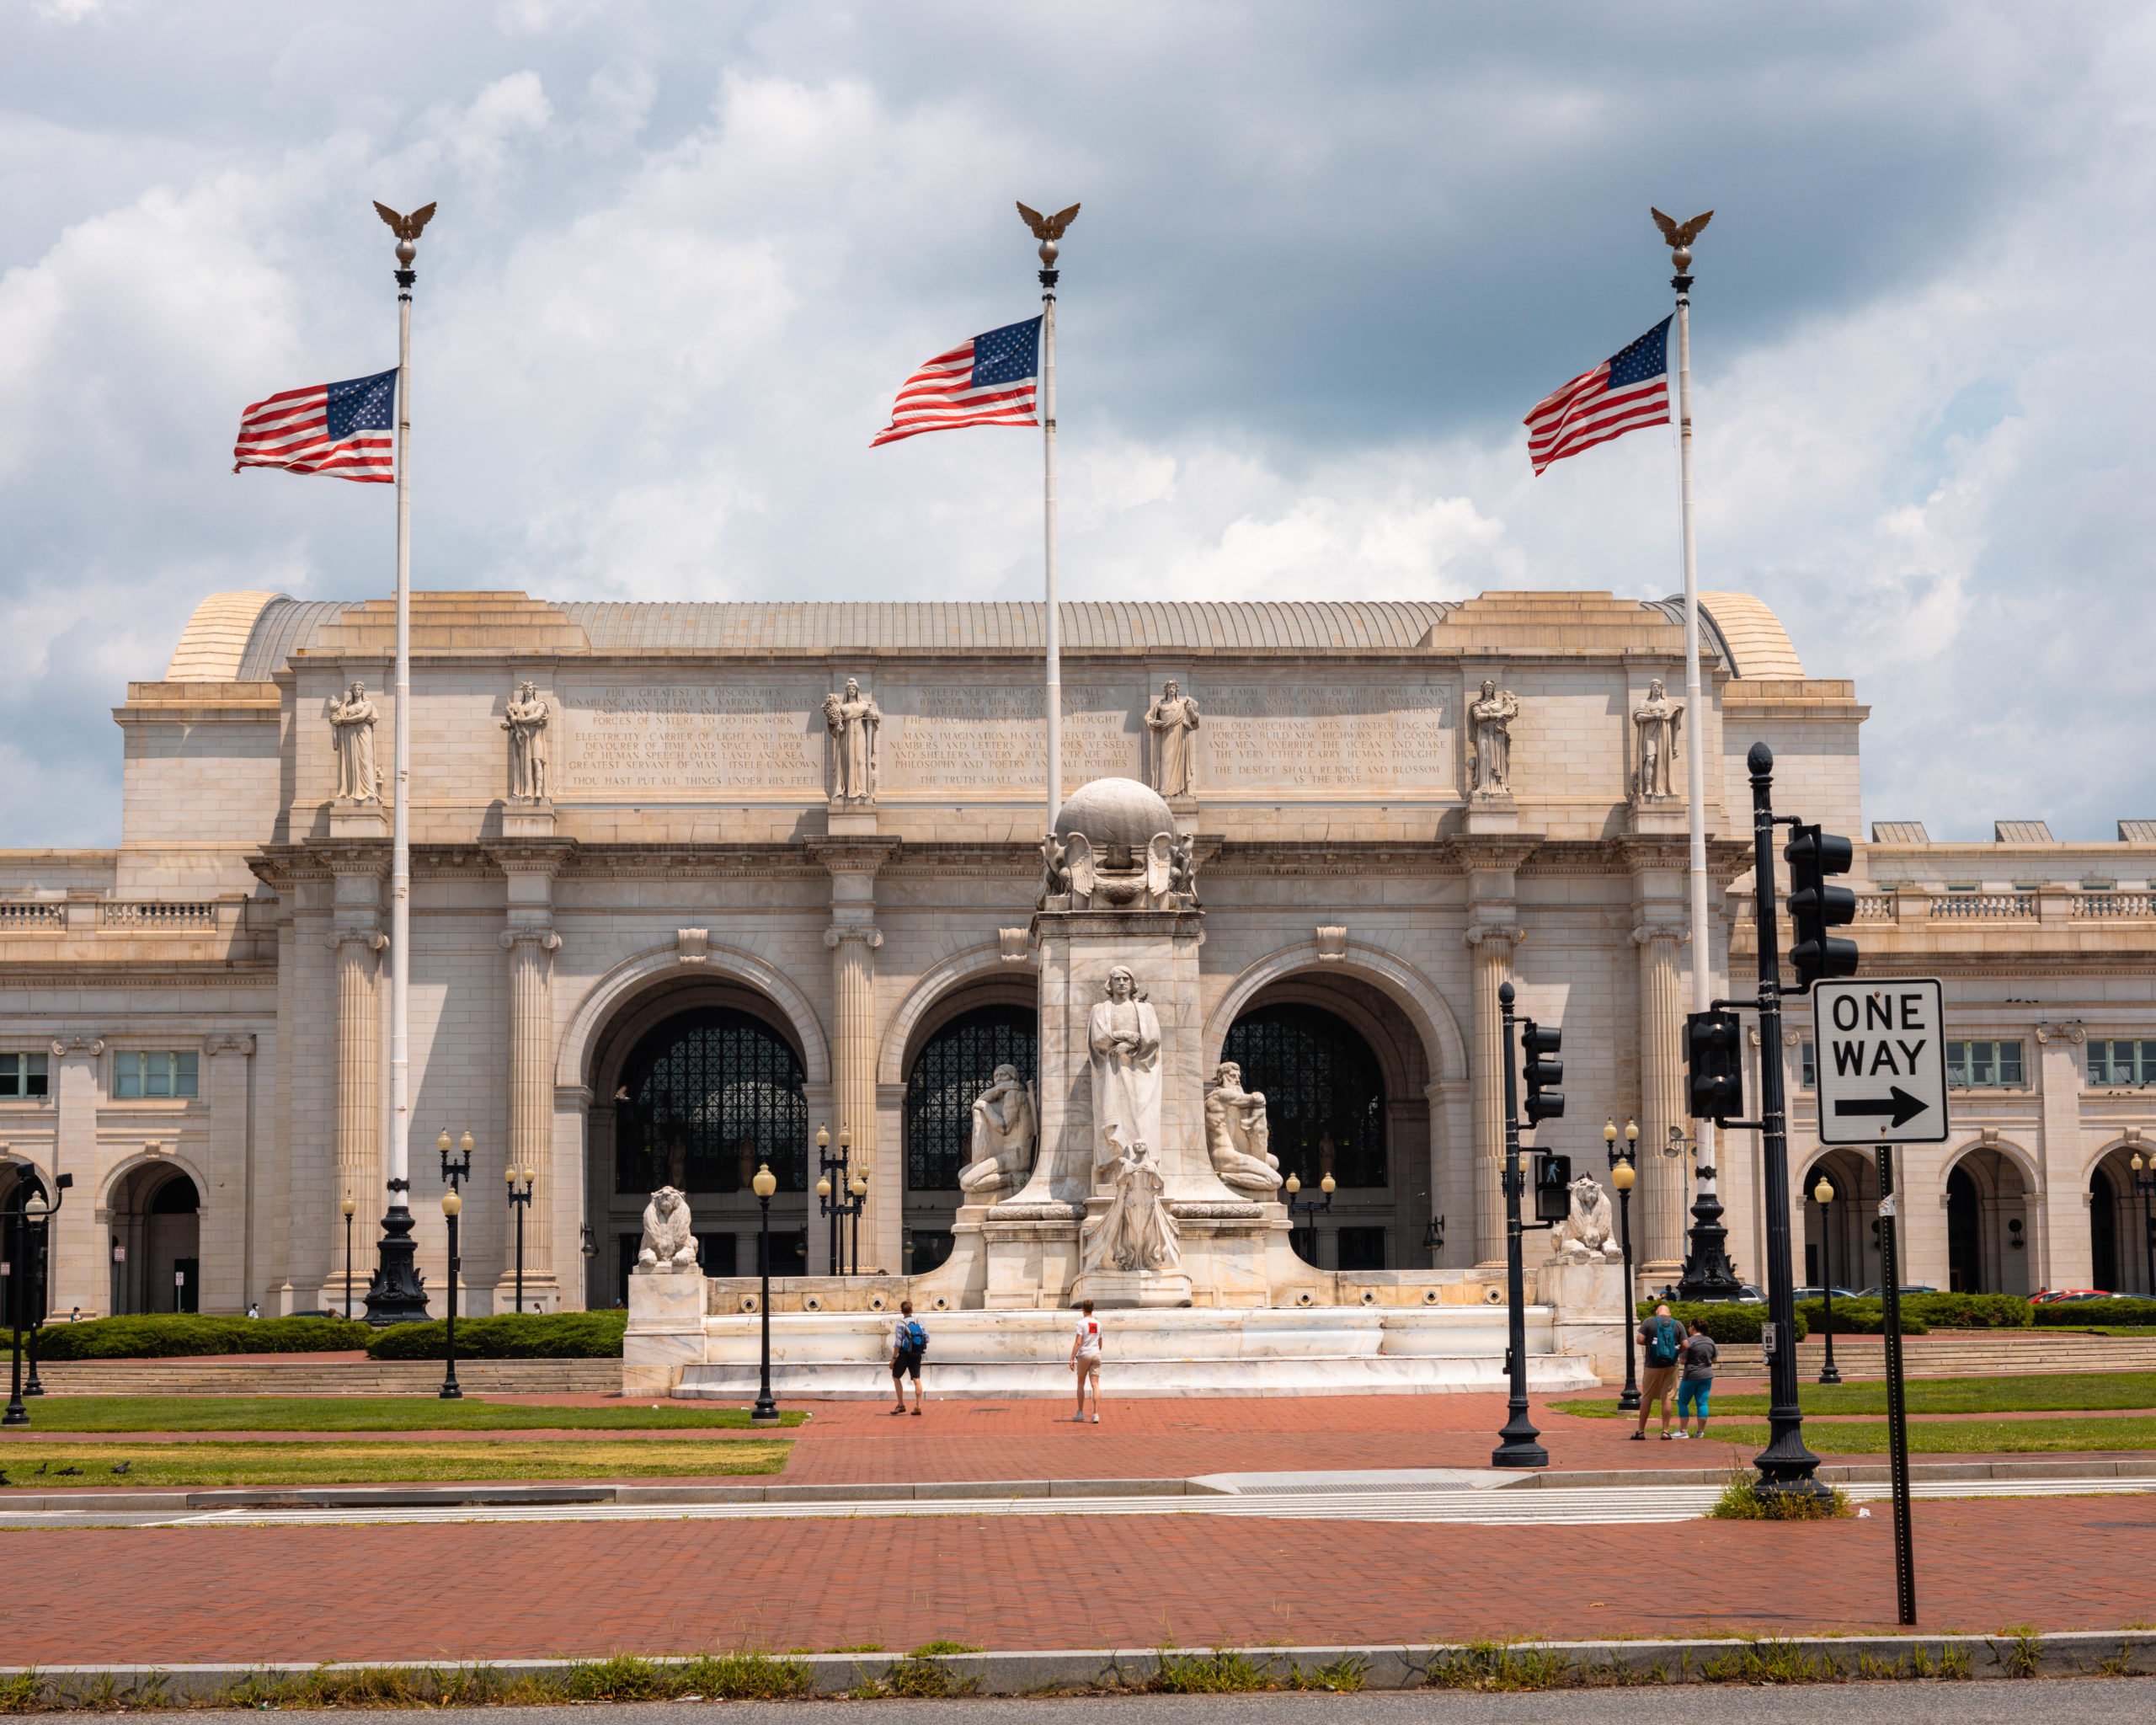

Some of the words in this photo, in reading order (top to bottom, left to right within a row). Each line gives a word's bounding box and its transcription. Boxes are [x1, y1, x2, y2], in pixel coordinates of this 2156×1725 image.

[1207, 687, 1225, 696] THE
[1231, 687, 1258, 696] FARM
[1331, 687, 1344, 696] OF
[1351, 687, 1369, 696] THE
[1374, 687, 1409, 696] FAMILY
[1420, 687, 1444, 696] MAIN
[570, 698, 620, 707] ENABLING
[627, 698, 648, 707] MAN
[656, 698, 668, 707] TO
[674, 698, 695, 707] LIVE
[701, 698, 710, 707] IN
[718, 698, 760, 707] VARIOUS
[766, 698, 816, 707] CLIMATES
[1213, 731, 1251, 740] FORCES
[1260, 731, 1289, 740] BUILD
[1295, 731, 1315, 740] NEW
[1322, 731, 1372, 740] HIGHWAYS
[1379, 731, 1396, 740] FOR
[1404, 731, 1438, 740] GOODS
[889, 741, 938, 750] NUMBERS
[946, 741, 967, 750] AND
[973, 741, 1016, 750] LETTERS
[1027, 741, 1044, 750] ALL
[1090, 741, 1134, 750] VESSELS
[1214, 766, 1232, 774] THE
[1239, 766, 1276, 774] DESERT
[1283, 766, 1314, 774] SHALL
[1321, 766, 1361, 774] REJOICE
[1368, 766, 1387, 774] AND
[1393, 766, 1439, 774] BLOSSOM
[1833, 994, 1925, 1031] ONE
[1833, 1039, 1926, 1076] WAY
